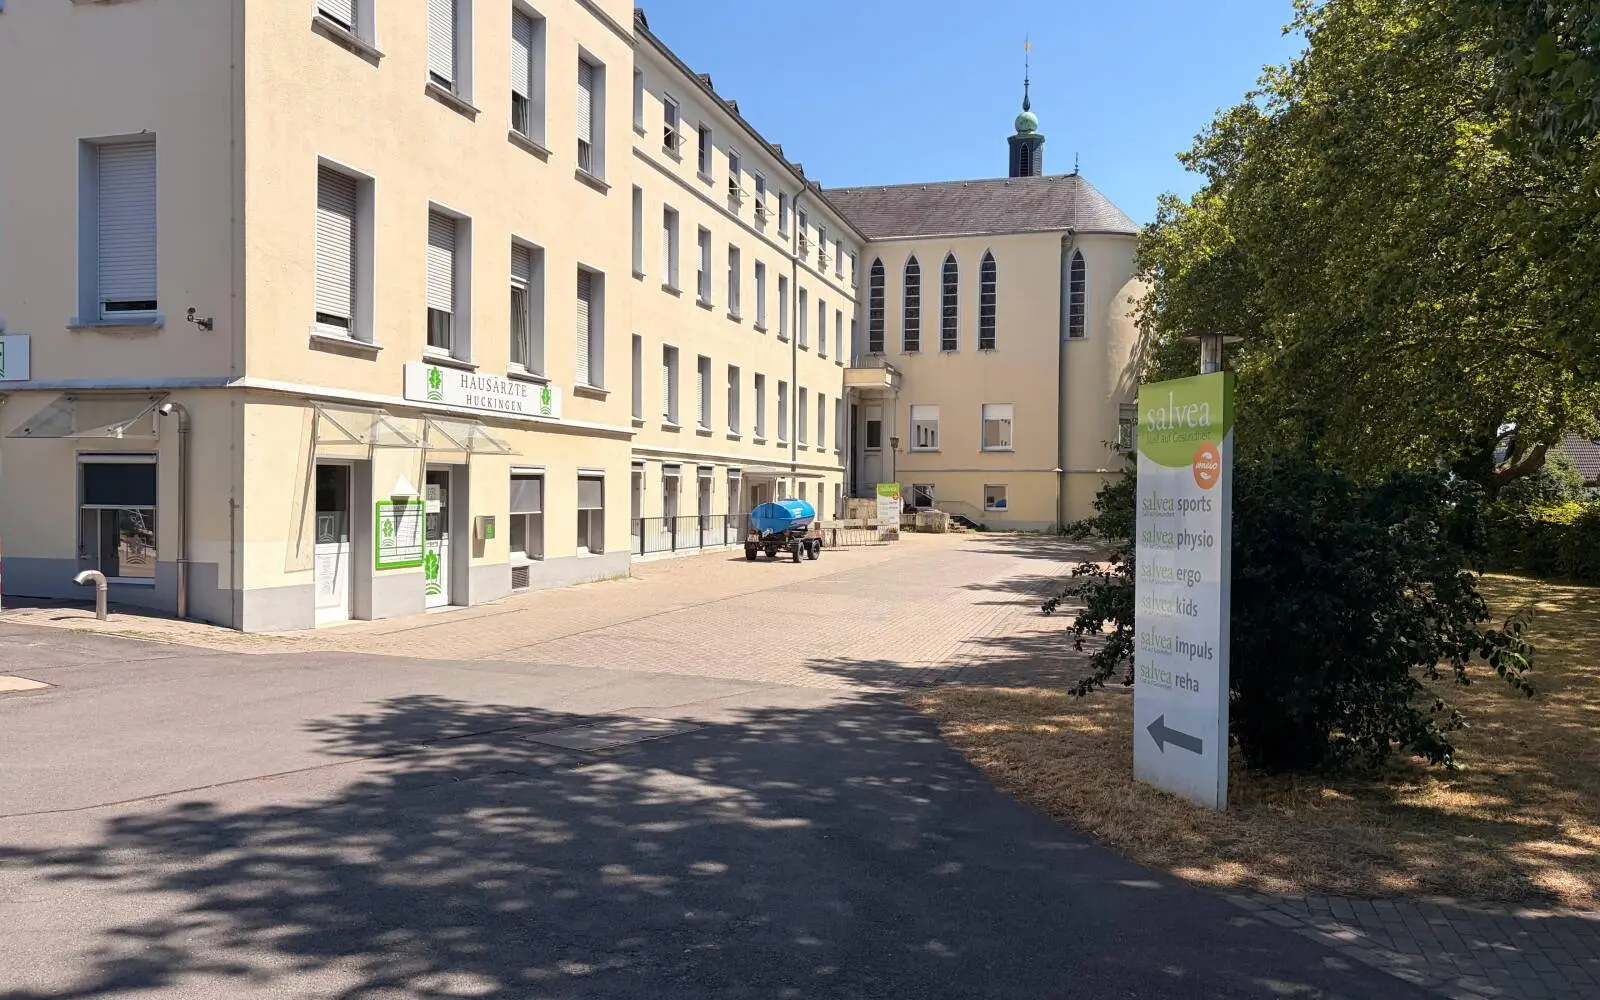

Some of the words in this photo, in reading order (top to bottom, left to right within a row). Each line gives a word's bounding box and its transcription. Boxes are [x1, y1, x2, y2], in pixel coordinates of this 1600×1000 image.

[460, 374, 528, 398] HAUSÄRZTE
[466, 394, 522, 411] HUCKINGEN
[1147, 391, 1211, 432] salvea
[1142, 491, 1174, 511] salvea
[1177, 496, 1212, 516] sports
[1142, 523, 1174, 544] salvea
[1177, 528, 1214, 551] physio
[1142, 559, 1173, 579] salvea
[1176, 568, 1201, 587] ergo
[1176, 596, 1198, 617] kids
[1141, 627, 1172, 650] salvea
[1175, 636, 1213, 661] impuls
[1140, 660, 1172, 684] salvea
[1175, 672, 1200, 692] reha
